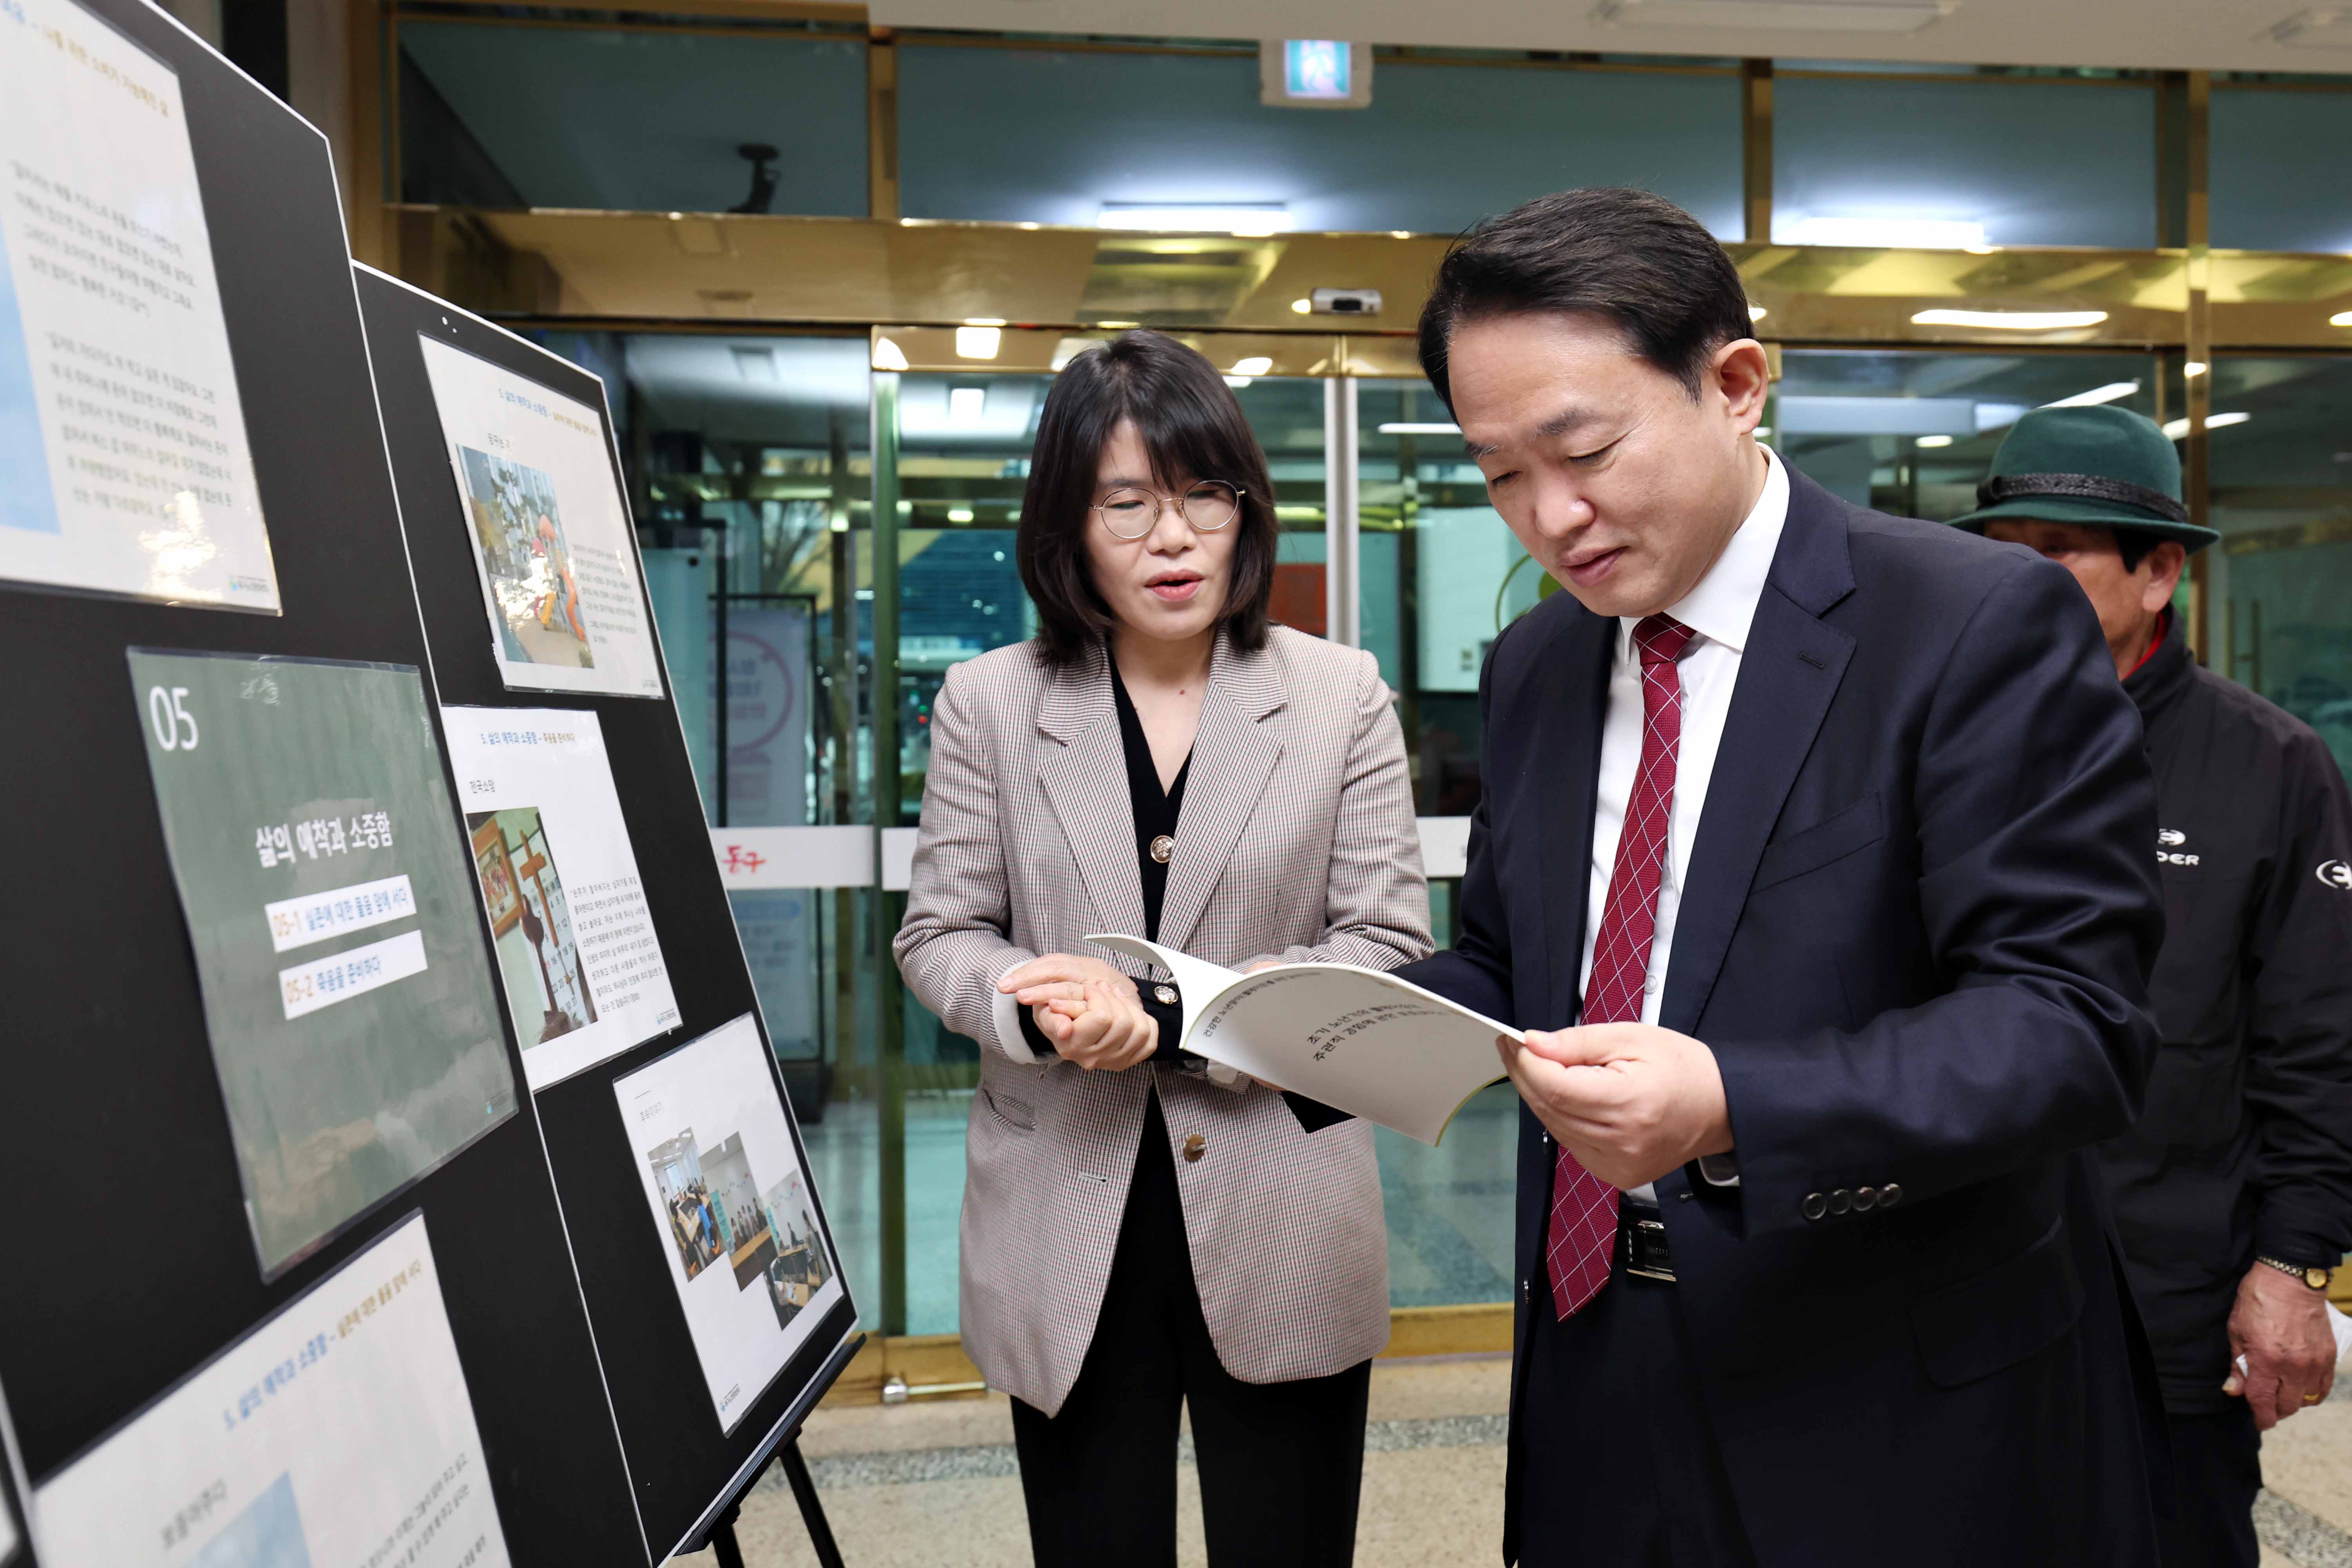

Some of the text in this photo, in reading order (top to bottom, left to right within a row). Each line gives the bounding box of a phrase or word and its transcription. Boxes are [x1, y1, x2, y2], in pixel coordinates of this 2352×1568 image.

[148, 685, 198, 751] 05
[488, 732, 501, 745] 삶의
[502, 731, 519, 744] 애착과
[521, 731, 537, 744] 소중함
[256, 811, 393, 868] 삶의 애착과 소중함
[722, 845, 767, 873] 동구
[2156, 851, 2200, 866] DER
[274, 910, 301, 937] 05-1
[561, 917, 568, 928] 12
[286, 955, 381, 1004] 05-2 죽음을 준비하다
[1203, 1016, 1222, 1038] 건강한
[1312, 1035, 1346, 1062] 주관적
